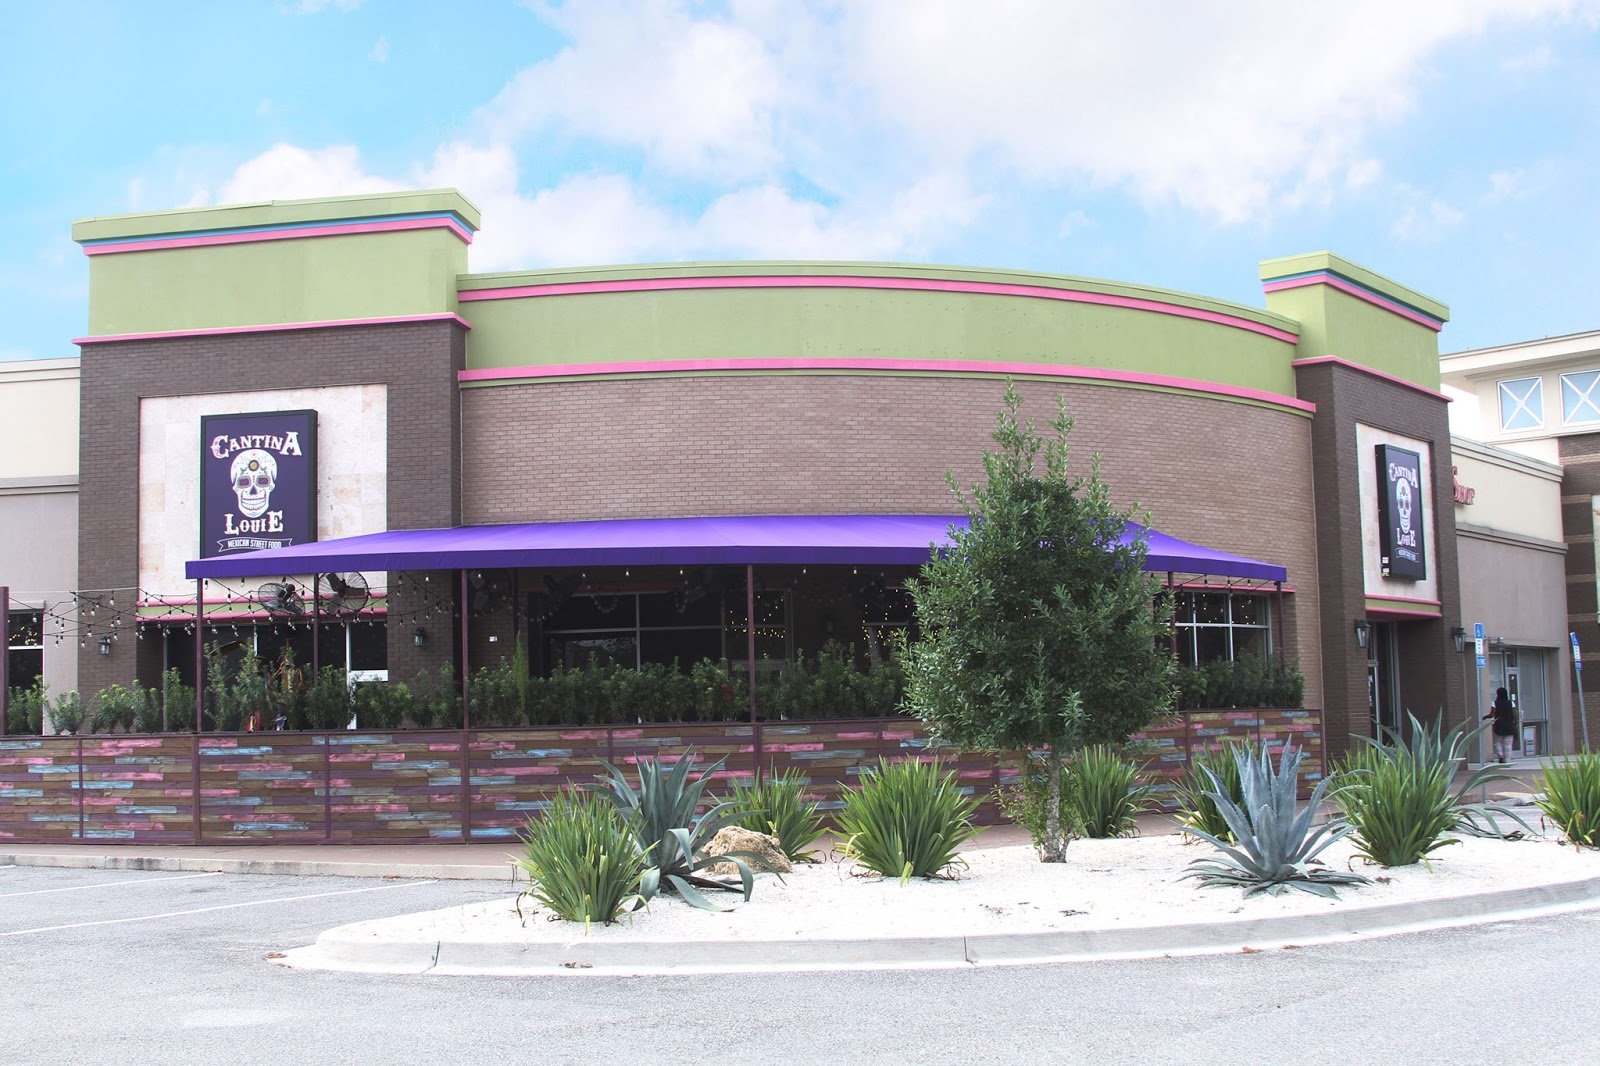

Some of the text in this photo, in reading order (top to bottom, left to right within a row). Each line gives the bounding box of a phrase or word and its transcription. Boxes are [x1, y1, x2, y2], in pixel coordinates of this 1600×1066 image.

[210, 431, 303, 459] CANTINA
[1388, 462, 1419, 489] CANTINA
[223, 510, 284, 536] LOUIE
[227, 539, 282, 550] MEXICAN STREET FOOD
